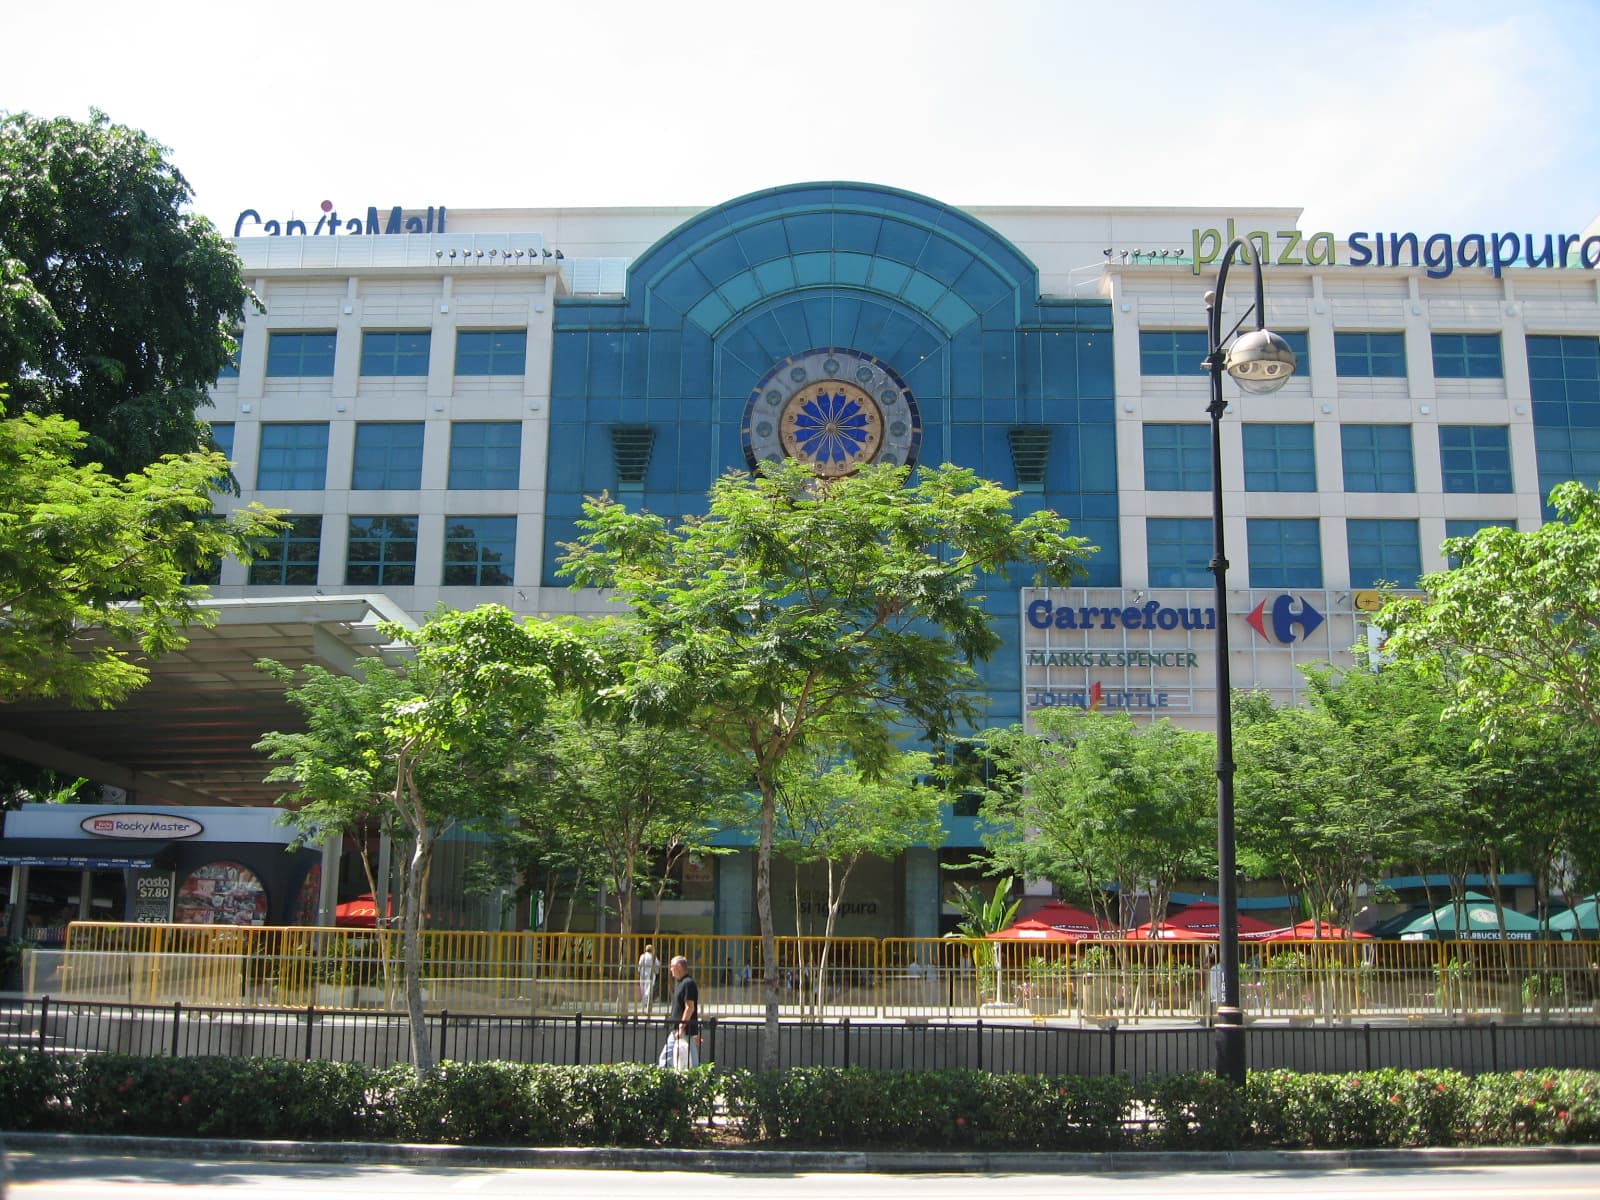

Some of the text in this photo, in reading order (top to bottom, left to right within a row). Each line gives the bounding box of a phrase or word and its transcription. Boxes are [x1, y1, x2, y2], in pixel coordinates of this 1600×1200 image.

[1192, 218, 1600, 278] plaza singapura
[1029, 652, 1199, 668] MARKS & SPENCER
[1028, 692, 1169, 707] JOHN LITTLE
[115, 821, 149, 832] Rocky
[150, 821, 190, 831] Master
[136, 876, 170, 890] pasta
[140, 887, 169, 898] $7.80
[1459, 932, 1532, 940] STRBUCKS COFFEE
